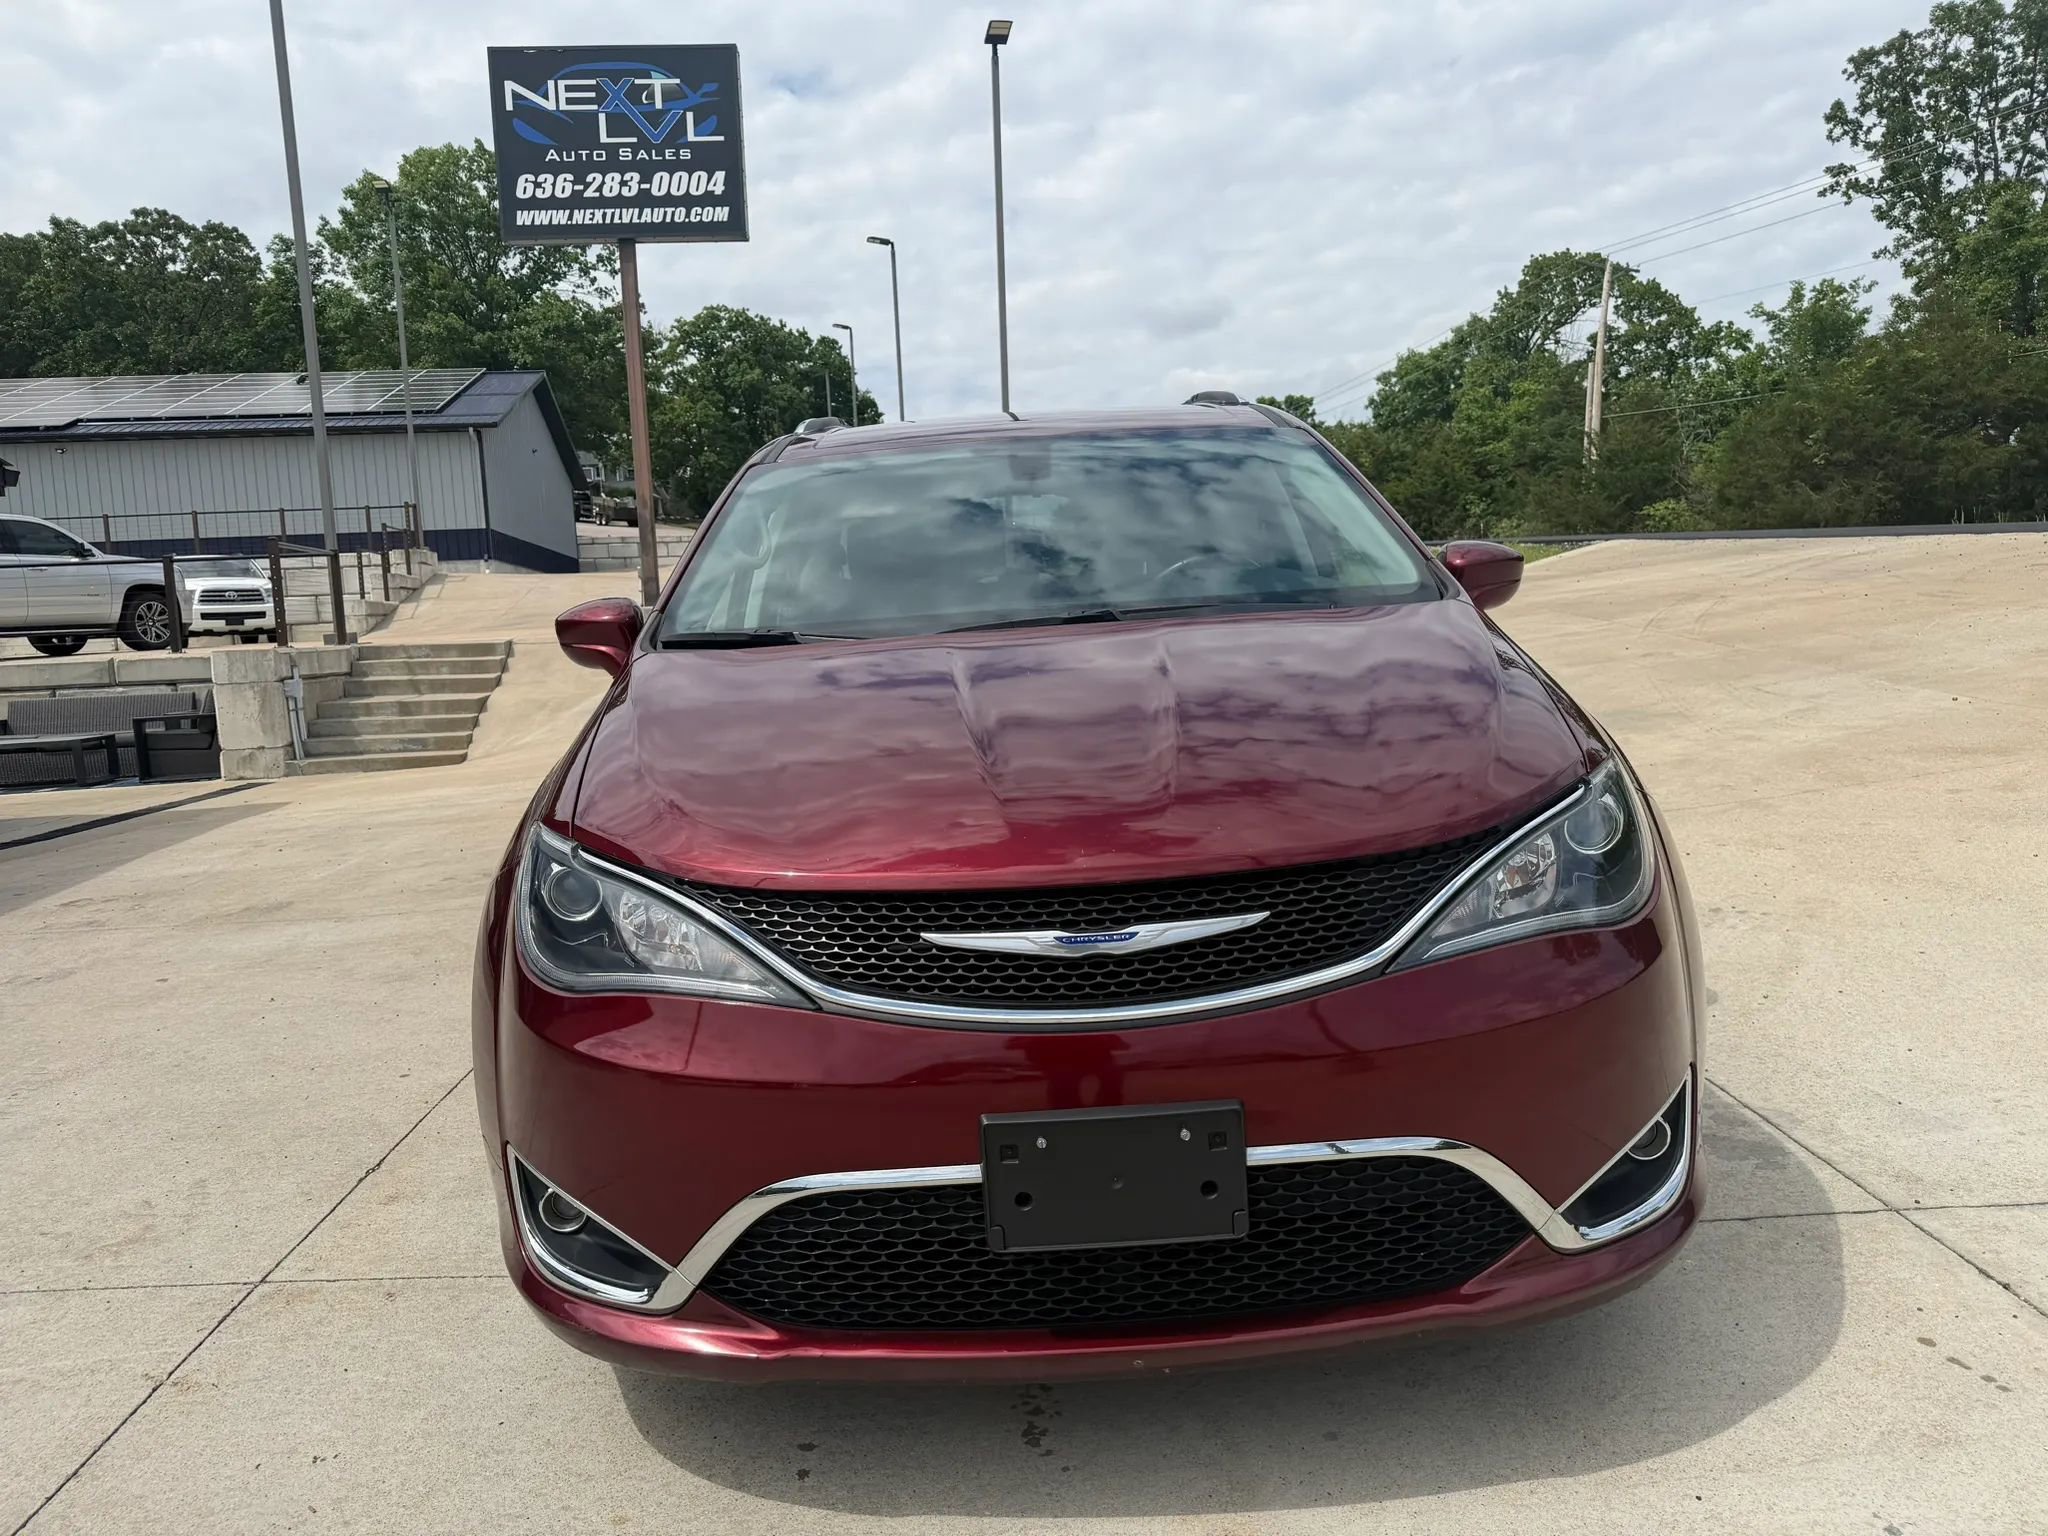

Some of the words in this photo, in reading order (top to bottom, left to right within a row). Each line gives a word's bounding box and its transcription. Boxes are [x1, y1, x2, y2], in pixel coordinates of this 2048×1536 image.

[504, 78, 680, 111] NEXT
[598, 110, 725, 143] LVL
[545, 149, 606, 161] AUTO
[618, 148, 692, 160] SALES
[515, 171, 726, 199] 636-283-0004
[516, 206, 729, 225] WWW.NEXTLVLAUTO.COM
[1062, 933, 1130, 943] CHRYSLER
